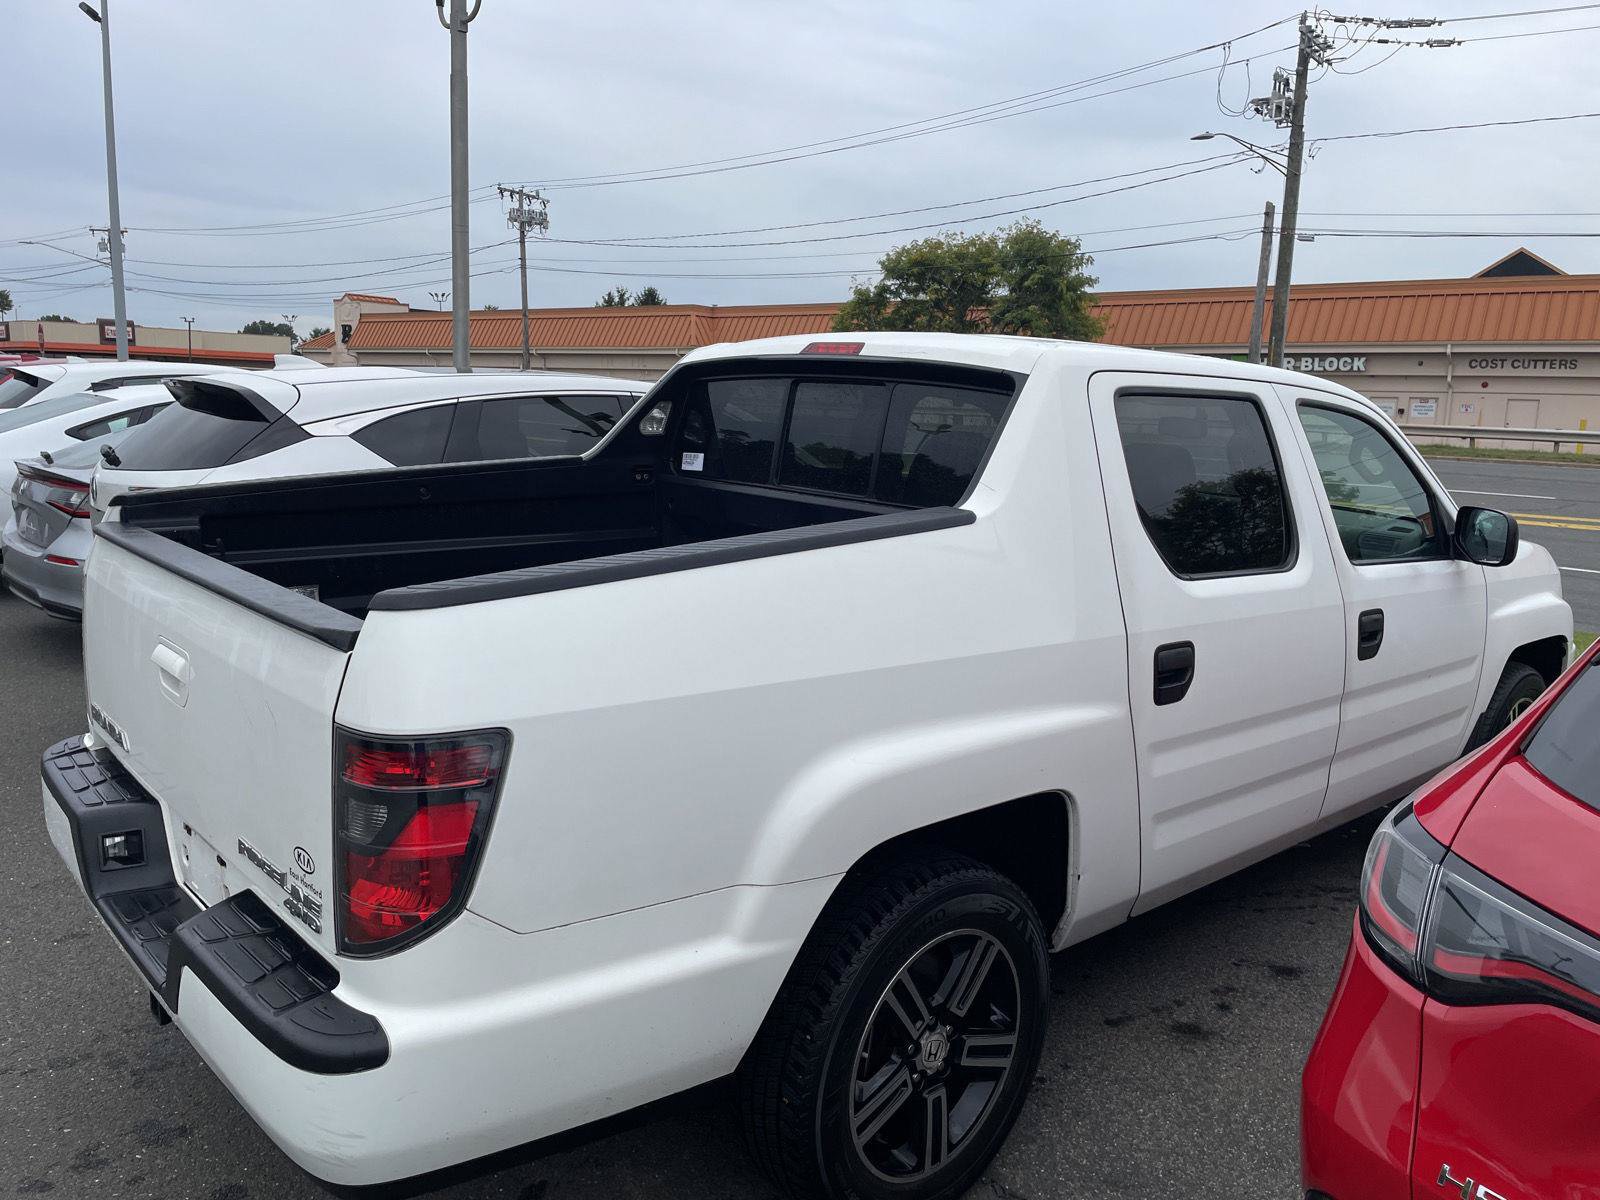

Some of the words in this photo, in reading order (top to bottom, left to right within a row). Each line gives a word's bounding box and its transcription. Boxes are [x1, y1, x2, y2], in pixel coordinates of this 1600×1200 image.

[1301, 357, 1367, 371] BLOCK
[1468, 358, 1508, 369] COST
[1510, 358, 1578, 370] CUTTERS
[296, 848, 313, 872] KIA
